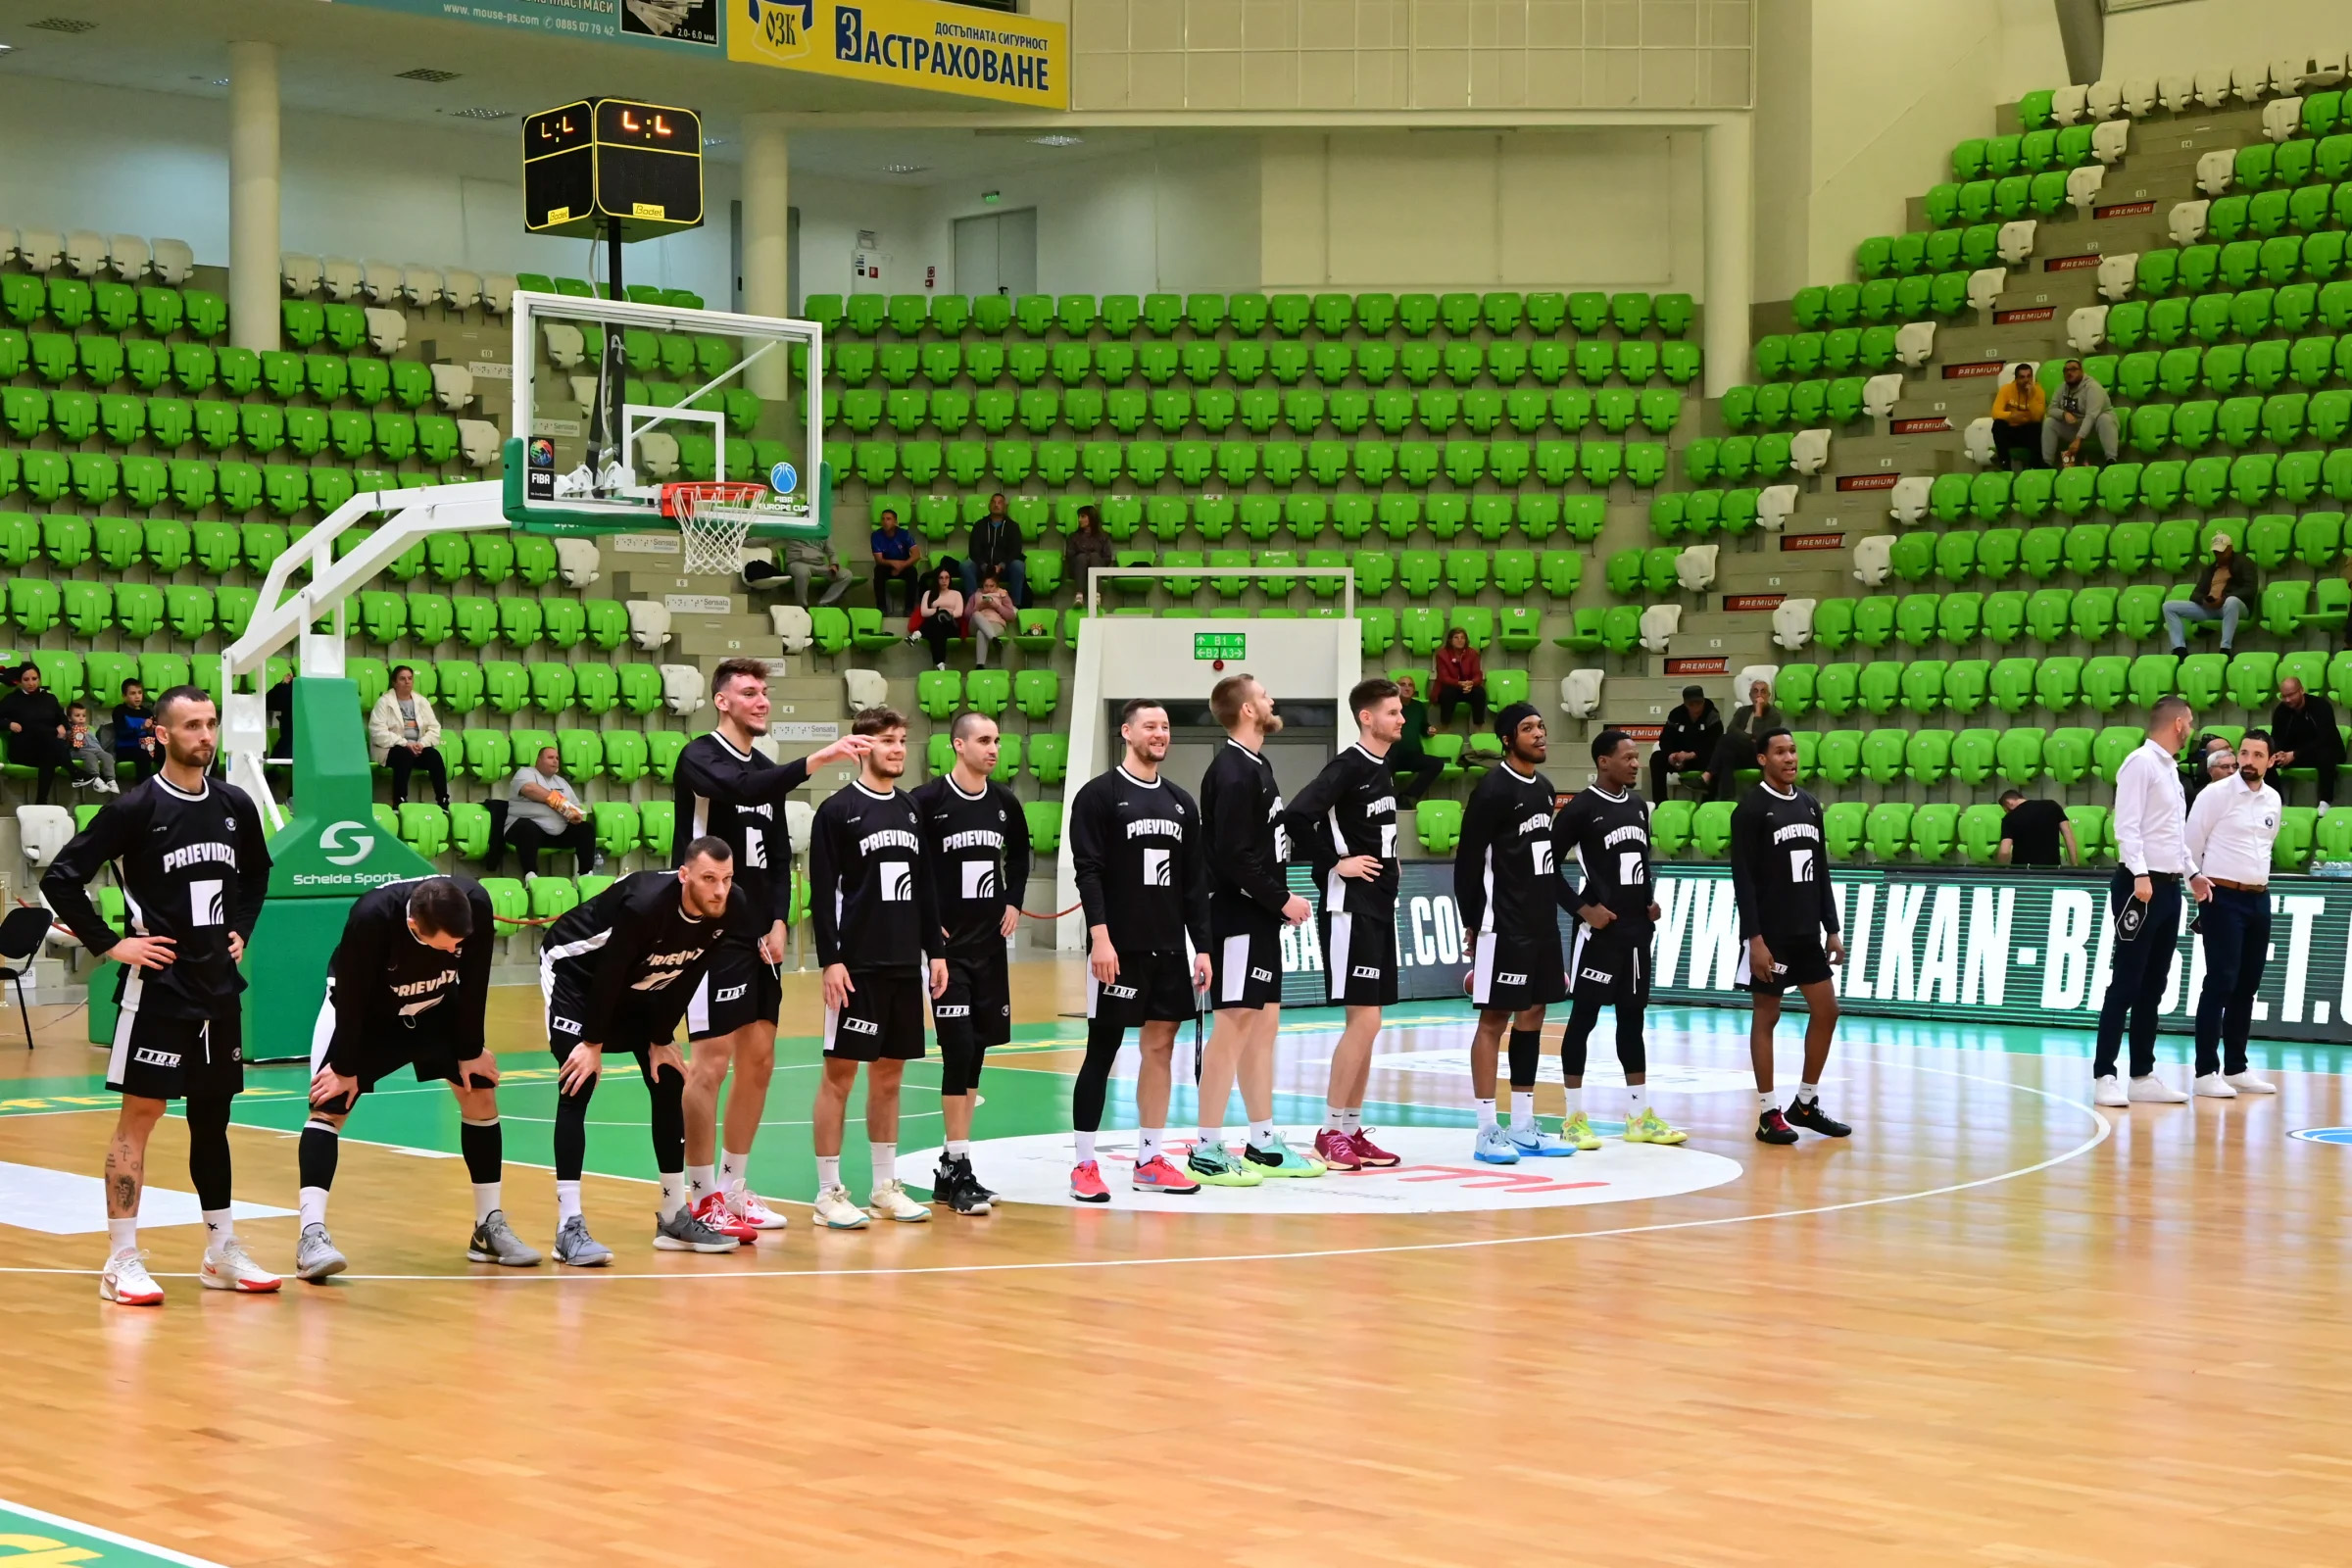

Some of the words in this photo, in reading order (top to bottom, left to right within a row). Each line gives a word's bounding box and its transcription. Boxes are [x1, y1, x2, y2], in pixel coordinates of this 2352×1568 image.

[472, 8, 539, 26] mouse-ps.com
[556, 19, 577, 29] 0885
[579, 23, 589, 32] 07
[591, 24, 601, 34] 79
[604, 26, 614, 36] 42
[692, 31, 703, 40] 6.0
[935, 22, 996, 43] ДОСТЪПНАТА
[998, 32, 1048, 51] СИГУРНОСТ
[550, 211, 568, 221] Bodet
[635, 205, 663, 218] Bodet
[2109, 206, 2151, 217] PREMIUM
[2061, 259, 2102, 269] PREMIUM
[2009, 312, 2050, 321] PREMIUM
[1958, 366, 2000, 375] PREMIUM
[1906, 421, 1948, 431] PREMIUM
[531, 472, 551, 485] FIBA
[1852, 477, 1894, 487] PREMIUM
[654, 538, 678, 547] Sensata
[1796, 538, 1839, 547] PREMIUM
[704, 598, 729, 607] Sensata
[1739, 599, 1781, 608] PREMIUM
[1214, 635, 1227, 646] B1
[1206, 648, 1219, 658] B2
[1221, 648, 1234, 658] A3
[1773, 823, 1820, 846] PRIEVIDZA
[163, 842, 239, 873] PRIEVIDZA
[293, 873, 352, 885] Schelde
[354, 872, 401, 886] Sports
